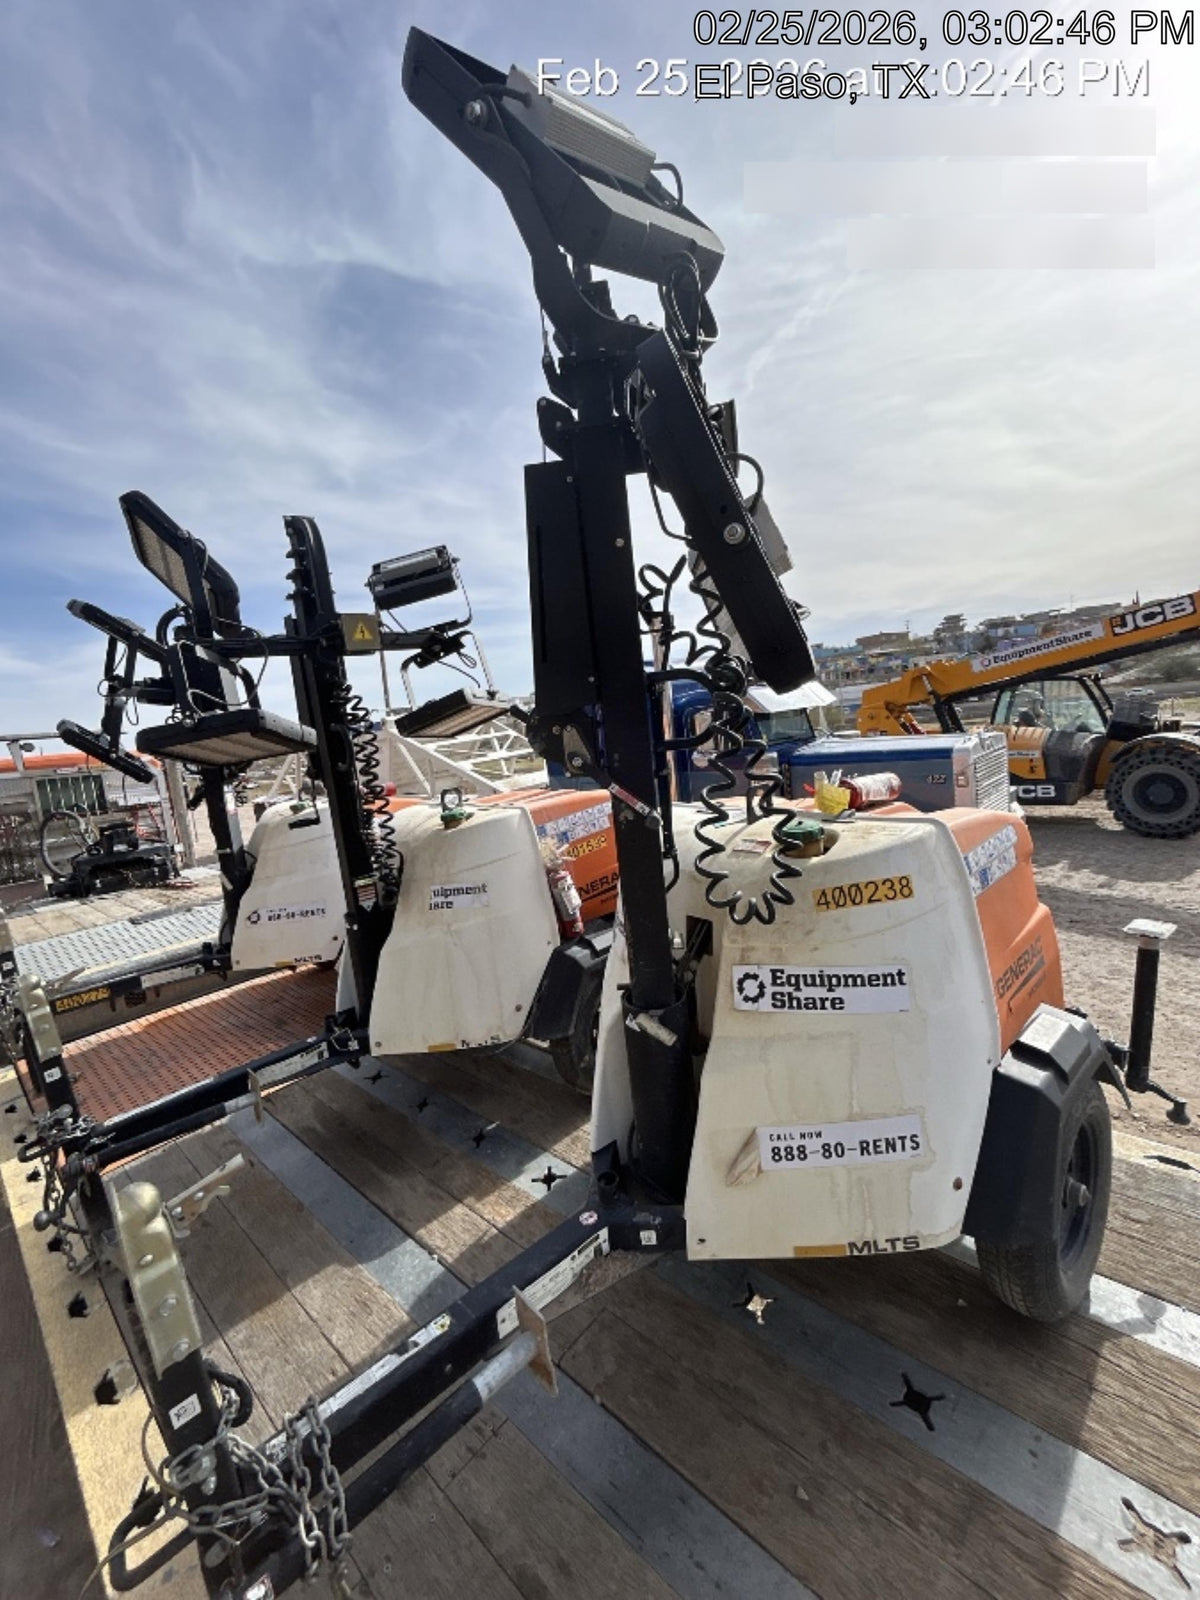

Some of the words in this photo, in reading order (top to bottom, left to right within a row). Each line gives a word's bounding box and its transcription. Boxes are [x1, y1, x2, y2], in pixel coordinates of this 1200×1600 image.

[1113, 596, 1196, 635] JCB
[1018, 785, 1056, 798] CB
[432, 883, 488, 899] uipment
[578, 871, 619, 898] NERA
[817, 876, 913, 910] 400238
[994, 935, 1045, 1000] GENERAC
[769, 968, 907, 993] Equipment
[770, 991, 846, 1011] Share
[769, 1132, 796, 1143] CALL
[799, 1130, 824, 1141] NOW
[770, 1133, 921, 1164] 888-80-RENTS
[847, 1235, 921, 1256] MLTS
